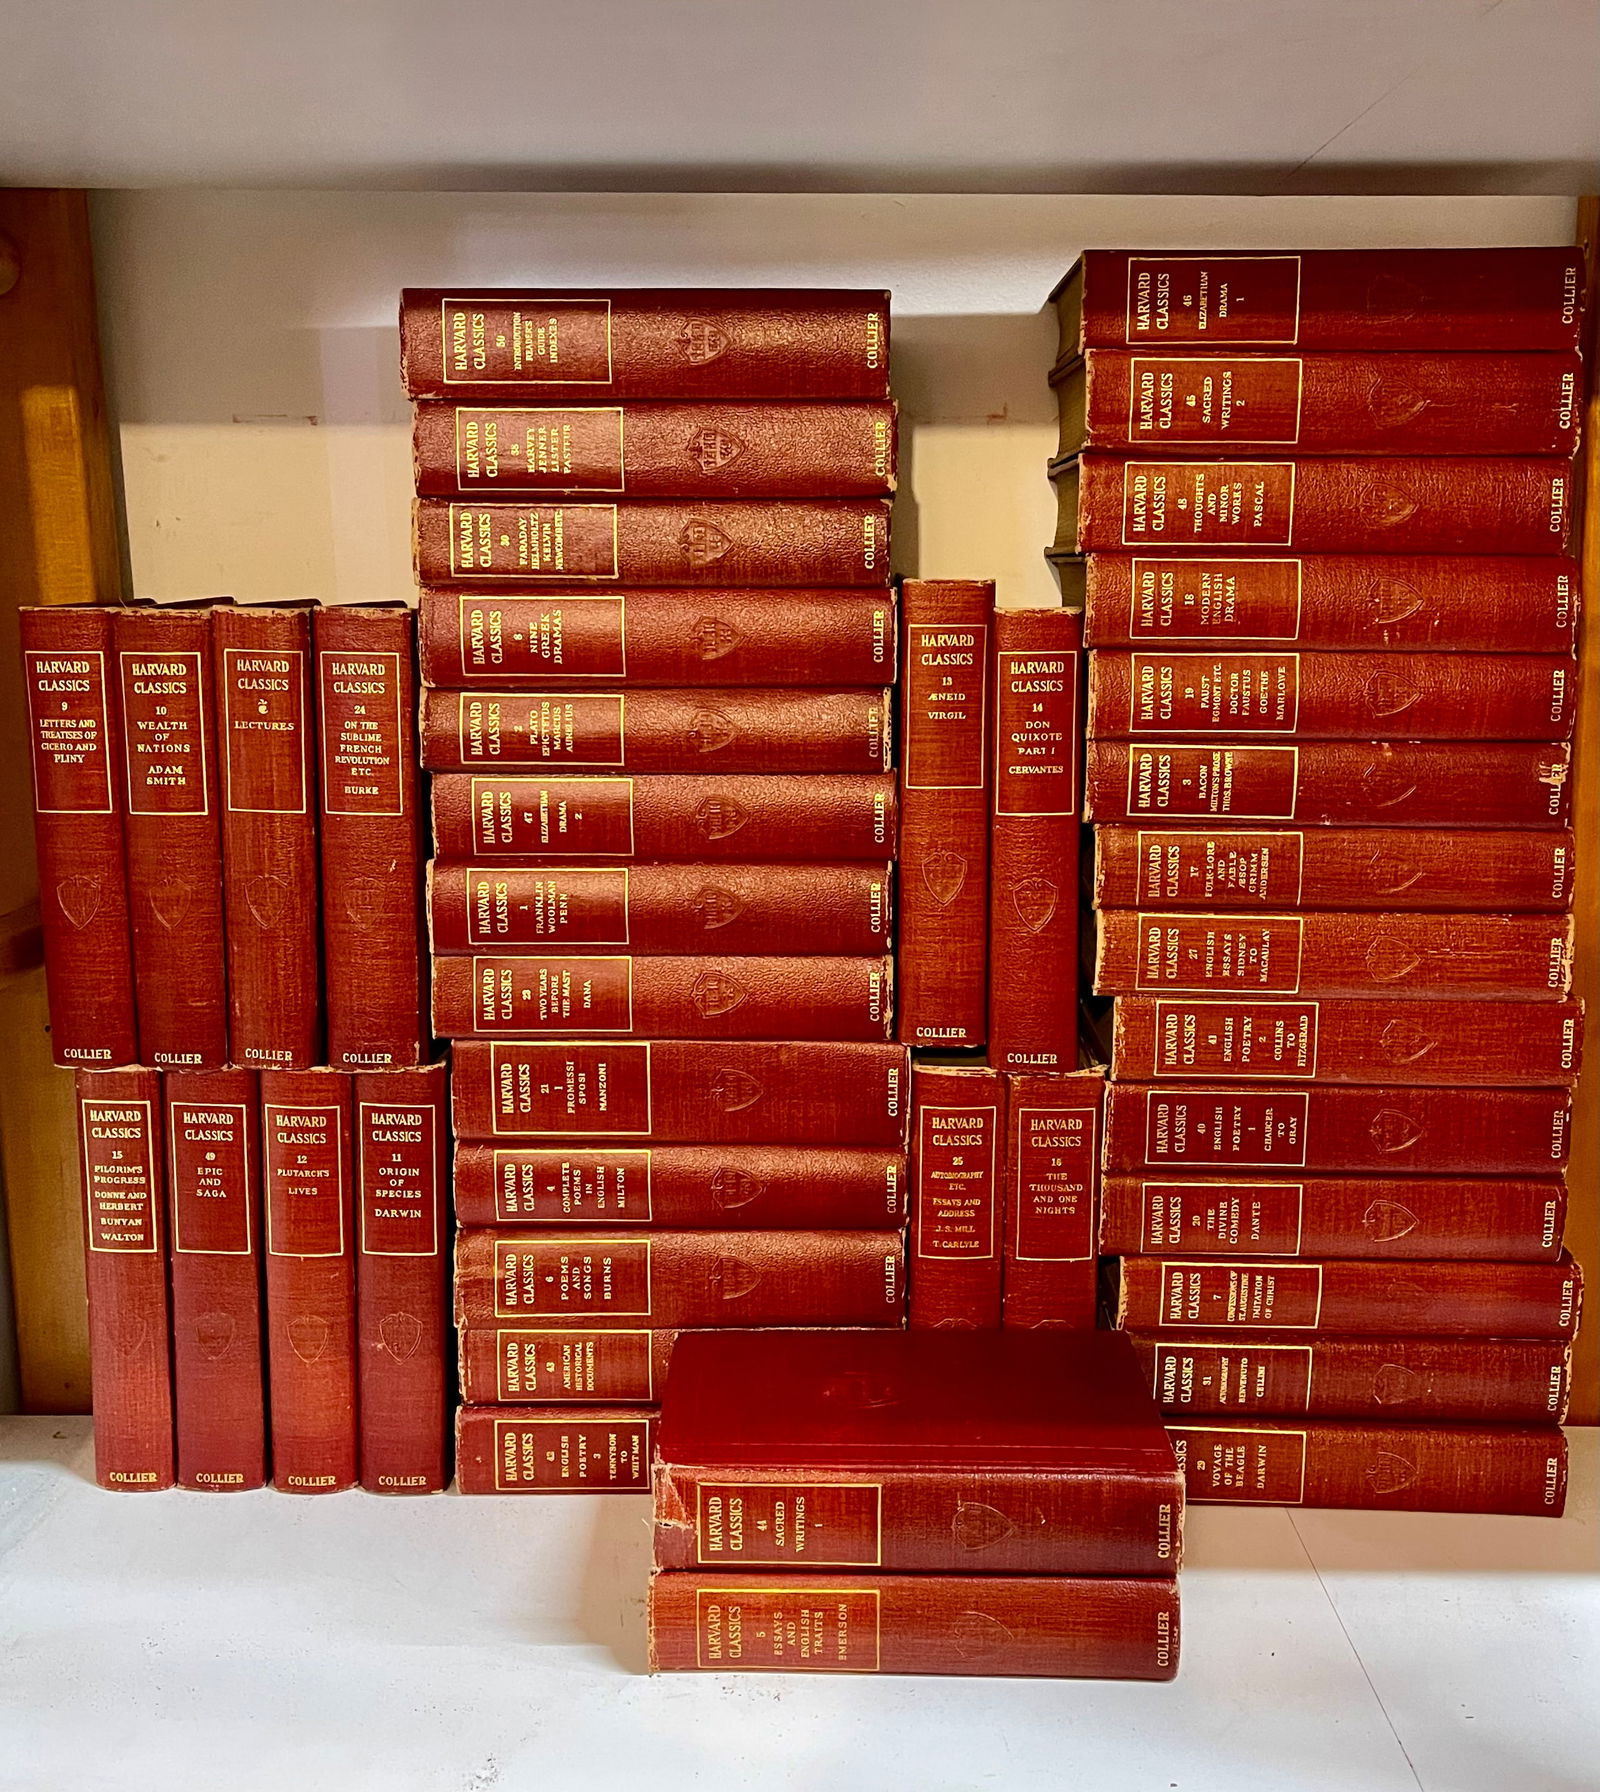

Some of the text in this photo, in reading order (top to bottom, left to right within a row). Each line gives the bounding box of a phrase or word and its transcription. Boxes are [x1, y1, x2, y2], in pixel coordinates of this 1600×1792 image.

[1136, 272, 1151, 331] HARVARD
[1155, 273, 1170, 330] CLASSICS
[1182, 294, 1193, 308] 46
[1218, 282, 1228, 318] DRAMA
[1561, 267, 1577, 325] COLLIER
[534, 326, 547, 356] GUIDE
[865, 312, 881, 369] COLLIER
[1201, 376, 1213, 424] SACRED
[1221, 370, 1233, 430] WRITINGS
[1558, 372, 1574, 430] COLLIER
[464, 421, 482, 479] HARVARD
[483, 422, 499, 478] CLASSICS
[525, 426, 537, 474] HARVEY
[537, 424, 548, 474] JENNER
[550, 427, 560, 473] LISTER
[1132, 475, 1148, 532] HARVARD
[1151, 476, 1167, 532] CLASSICS
[1177, 497, 1188, 511] 48
[1193, 473, 1205, 534] THOUGHTS
[1206, 492, 1217, 516] AND
[1231, 482, 1243, 526] WORKS
[1253, 481, 1265, 528] PASCAL
[516, 516, 529, 566] FARADAY
[1184, 593, 1195, 606] 18
[1200, 572, 1212, 625] MODERN
[1223, 575, 1236, 623] DRAMA
[1555, 575, 1569, 628] COLLIER
[540, 613, 551, 659] GREEK
[552, 609, 563, 665] DRAMAS
[872, 609, 885, 663] COLLIER
[35, 660, 90, 674] HARVARD
[38, 679, 91, 692] CLASSICS
[1010, 661, 1065, 675] HARVARD
[1010, 679, 1064, 693] CLASSICS
[61, 701, 69, 712] 9
[155, 705, 168, 716] 10
[353, 704, 367, 715] 24
[927, 692, 966, 702] ÆNEID
[1184, 687, 1195, 699] 19
[1229, 672, 1239, 715] DOCTOR
[1241, 669, 1252, 716] FAUSTUS
[1259, 670, 1269, 714] GOETHE
[1550, 669, 1565, 722] COLLIER
[136, 720, 188, 731] WEALTH
[233, 720, 295, 731] LECTURES
[513, 725, 523, 733] 2
[529, 709, 539, 745] PLATO
[552, 706, 562, 751] MARCUS
[927, 711, 967, 720] VIRGIL
[1024, 720, 1051, 730] DON
[40, 742, 98, 752] CICERO AND
[136, 743, 191, 753] NATIONS
[154, 732, 170, 742] OF
[339, 743, 383, 754] FRENCH
[340, 732, 383, 743] SUBLIME
[1010, 732, 1063, 744] QUIXOTE
[53, 753, 86, 764] PLINY
[1008, 765, 1064, 775] CERVANTES
[146, 776, 186, 786] SMITH
[1182, 778, 1192, 786] 3
[1198, 764, 1208, 799] BACON
[558, 800, 568, 833] DRAMA
[1189, 865, 1200, 878] 17
[1248, 852, 1259, 893] GRIMM
[1551, 847, 1566, 899] COLLIER
[476, 881, 492, 934] HARVARD
[495, 882, 509, 934] CLASSICS
[534, 881, 545, 934] FRANKLIN
[547, 880, 557, 934] WOOLMAN
[558, 893, 571, 924] PENN
[1236, 932, 1247, 977] SIDNEY
[1259, 928, 1273, 983] MACAULAY
[550, 974, 560, 1014] BEFORE
[582, 979, 592, 1009] DANA
[916, 1026, 967, 1039] COLLIER
[1163, 1013, 1179, 1065] HARVARD
[1182, 1014, 1196, 1065] CLASSICS
[1223, 1017, 1234, 1062] ENGLISH
[1241, 1015, 1253, 1063] POETRY
[1273, 1020, 1285, 1061] COLLINS
[1560, 1018, 1575, 1069] COLLIER
[63, 1048, 113, 1060] COLLIER
[342, 1052, 393, 1064] COLLIER
[565, 1060, 576, 1114] PROMESSI
[577, 1072, 587, 1105] SPOSI
[597, 1062, 608, 1112] MANZONI
[887, 1067, 899, 1117] COLLIER
[371, 1112, 423, 1126] HARVARD
[371, 1129, 422, 1143] CLASSICS
[1196, 1123, 1206, 1135] 40
[1232, 1105, 1242, 1152] POETRY
[111, 1150, 124, 1160] 15
[197, 1166, 223, 1176] EPIC
[296, 1154, 308, 1164] 12
[378, 1167, 420, 1177] ORIGIN
[391, 1152, 402, 1163] 11
[93, 1174, 146, 1185] PROGRESS
[195, 1188, 227, 1199] SAGA
[198, 1177, 222, 1187] AND
[288, 1186, 318, 1196] LIVES
[375, 1188, 422, 1199] SPECIES
[389, 1178, 405, 1187] OF
[572, 1169, 582, 1206] POEMS
[616, 1167, 626, 1209] MILTON
[1028, 1183, 1084, 1193] THOUSAND
[1032, 1194, 1079, 1204] AND ONE
[374, 1208, 422, 1219] DARWIN
[936, 1209, 976, 1218] ADDRESS
[1035, 1206, 1076, 1215] NIGHTS
[1150, 1195, 1164, 1245] HARVARD
[1168, 1196, 1182, 1244] CLASSICS
[1191, 1215, 1201, 1227] 20
[1229, 1196, 1240, 1245] COMEDY
[1250, 1201, 1261, 1241] DANTE
[100, 1232, 145, 1242] WALTON
[504, 1253, 518, 1306] HARVARD
[522, 1254, 535, 1305] CLASSICS
[544, 1275, 554, 1283] 6
[560, 1256, 570, 1301] POEMS
[571, 1266, 581, 1290] AND
[582, 1255, 592, 1300] SONGS
[602, 1256, 612, 1300] BURNS
[884, 1254, 896, 1304] COLLIER
[1264, 1274, 1276, 1320] OF CHRIST
[506, 1342, 520, 1392] HARVARD
[523, 1343, 537, 1392] CLASSICS
[562, 1344, 571, 1390] AMERICAN
[1238, 1357, 1249, 1404] BENVENUTO
[578, 1433, 588, 1478] POETRY
[1212, 1443, 1223, 1488] VOYAGE
[1223, 1446, 1235, 1486] OF THE
[1235, 1445, 1246, 1488] BEAGLE
[1256, 1444, 1267, 1490] DARWIN
[109, 1471, 158, 1483] COLLIER
[287, 1475, 337, 1487] COLLIER
[1544, 1457, 1558, 1505] COLLIER
[708, 1496, 724, 1552] HARVARD
[728, 1497, 743, 1551] CLASSICS
[774, 1500, 785, 1547] SACRED
[795, 1496, 806, 1553] WRITINGS
[1157, 1503, 1171, 1559] COLLIER
[786, 1621, 797, 1647] AND
[799, 1608, 812, 1659] ENGLISH
[813, 1610, 824, 1655] TRAITS
[1156, 1611, 1170, 1667] COLLIER
